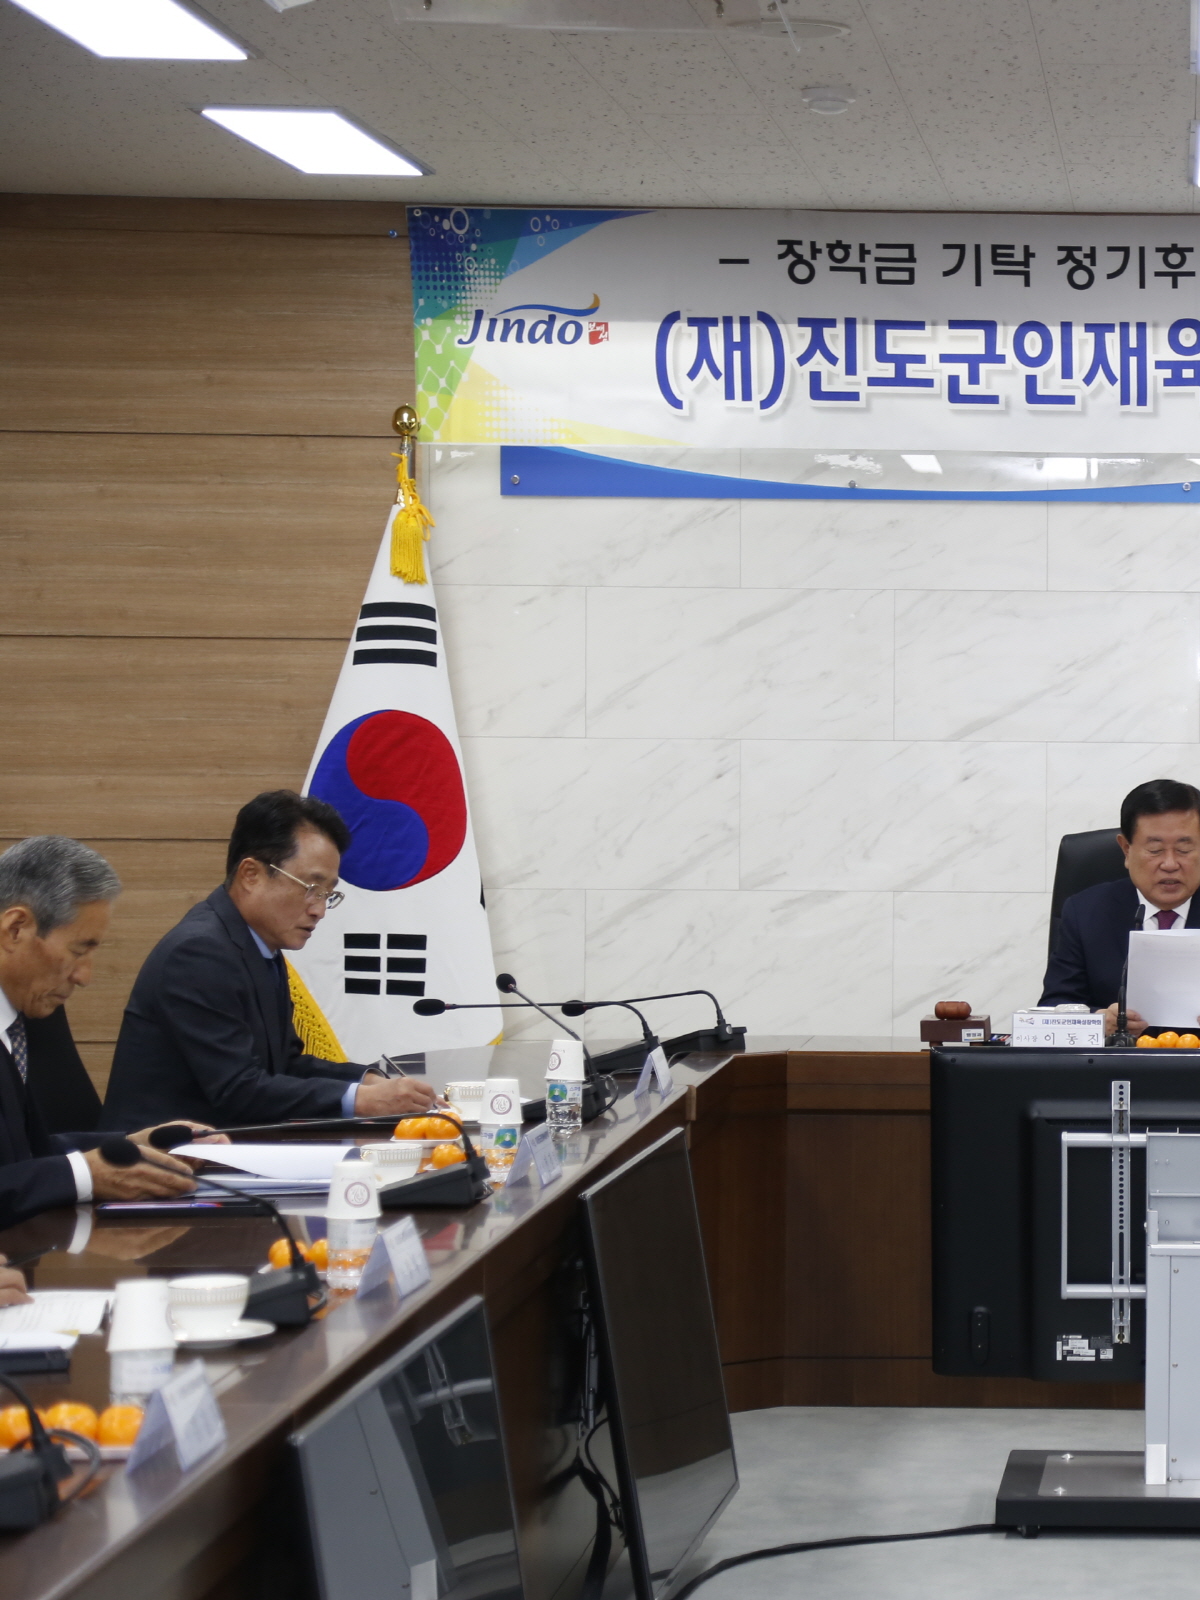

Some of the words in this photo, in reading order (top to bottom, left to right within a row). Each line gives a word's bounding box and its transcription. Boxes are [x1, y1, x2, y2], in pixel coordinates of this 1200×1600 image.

[777, 239, 917, 287] 장학금
[942, 243, 1036, 287] 기탁
[457, 309, 584, 345] Jindo
